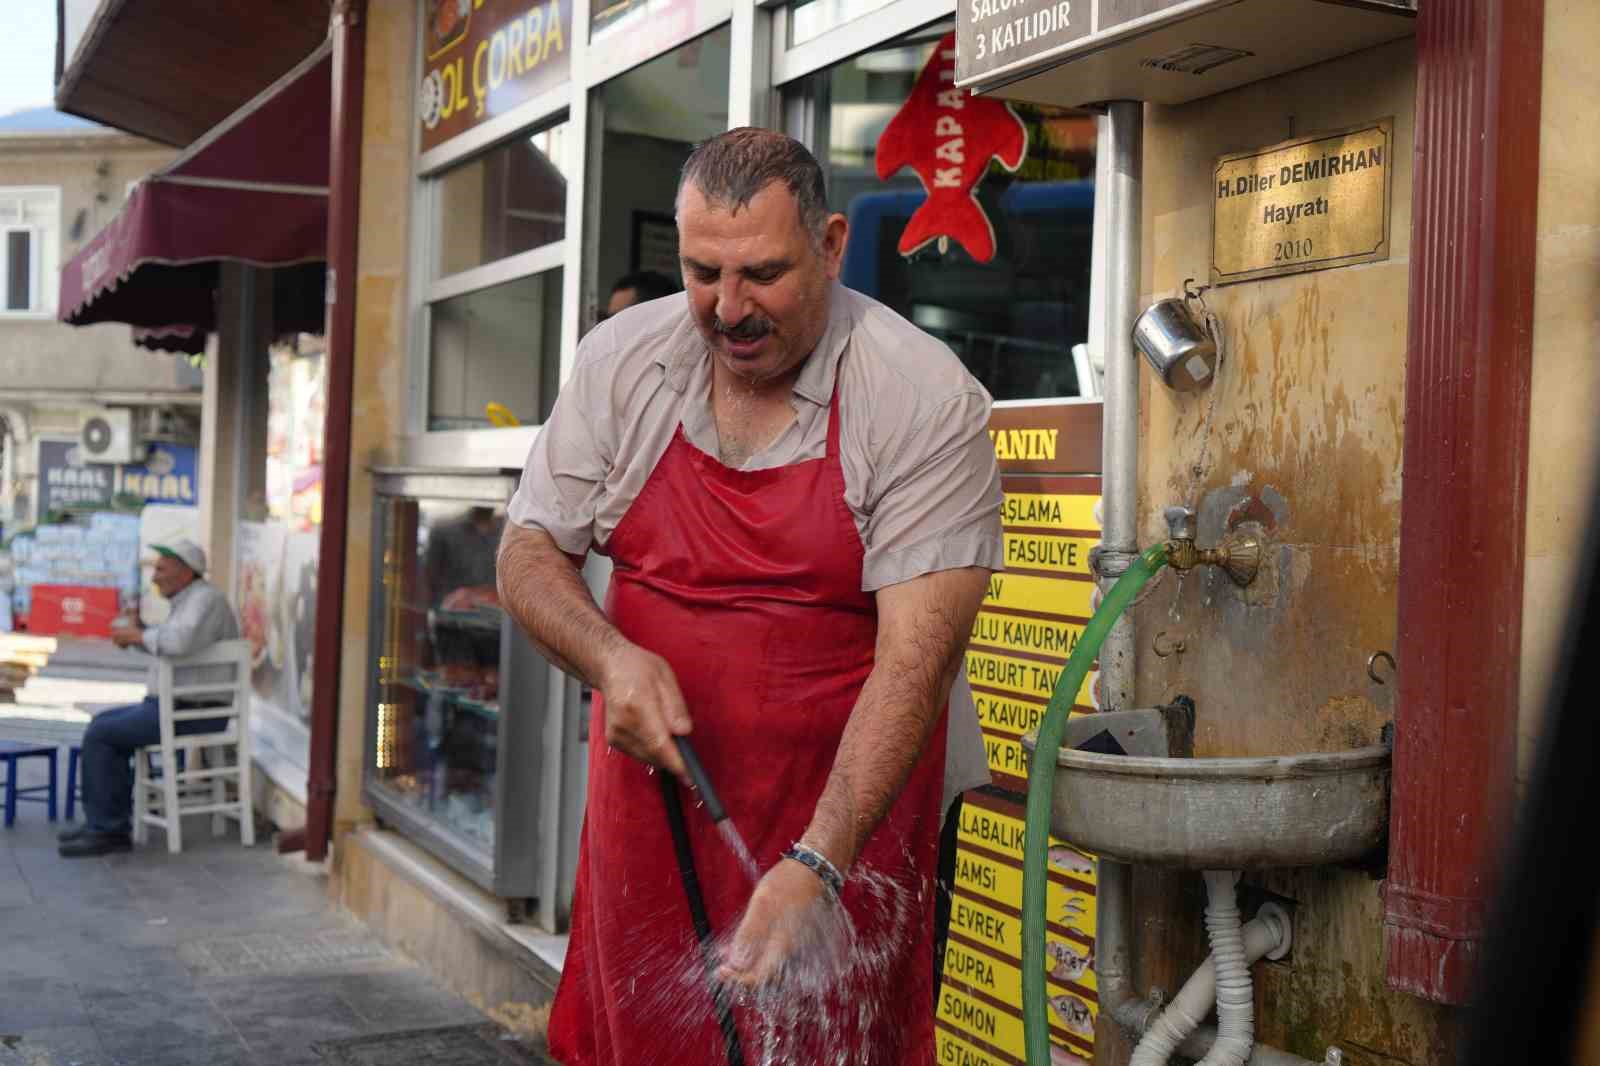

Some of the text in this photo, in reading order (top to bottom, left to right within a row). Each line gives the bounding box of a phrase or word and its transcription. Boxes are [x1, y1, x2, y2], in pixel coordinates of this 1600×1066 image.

[975, 2, 1070, 60] 3 KATLIDIR
[473, 0, 563, 119] ÇORBA
[1280, 146, 1383, 186] DEMİRHAN
[1263, 195, 1329, 225] Hayratı
[1273, 238, 1313, 262] 2010
[989, 429, 1058, 460] ANIN
[1008, 539, 1078, 567] FASULYE
[1003, 620, 1080, 654] KAVURMA
[966, 655, 1027, 688] AYBURT
[959, 811, 1025, 852] LABALIK
[944, 993, 996, 1037] SOMON
